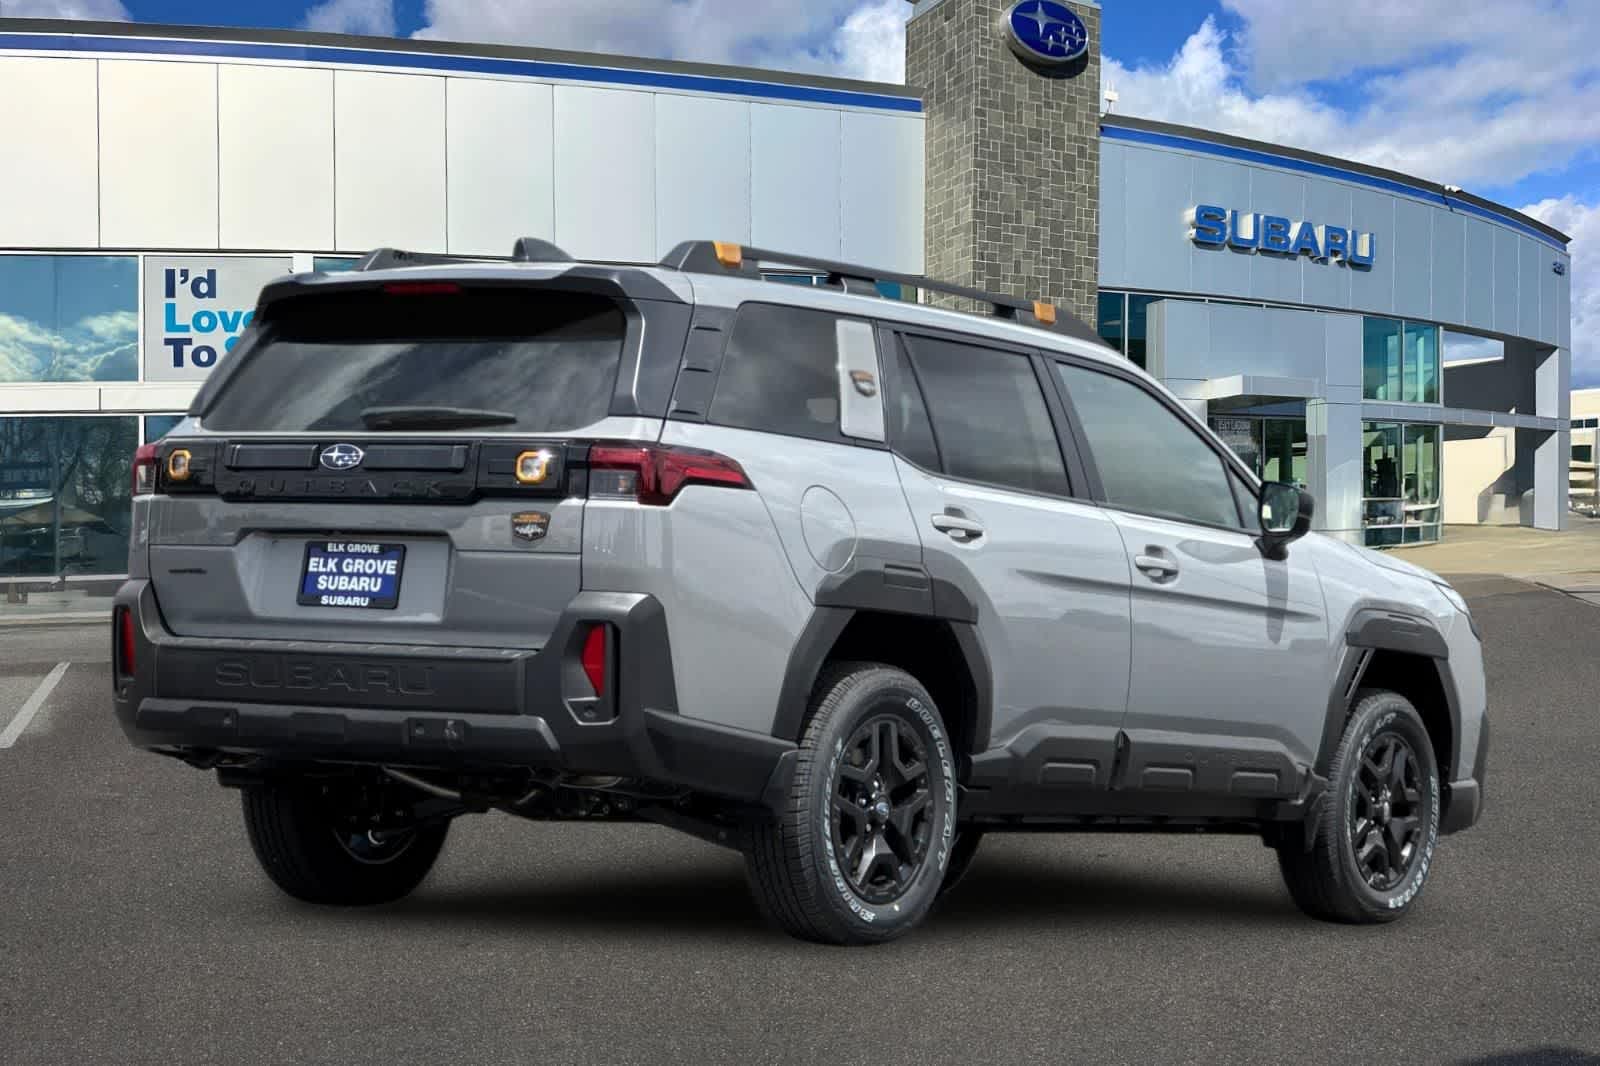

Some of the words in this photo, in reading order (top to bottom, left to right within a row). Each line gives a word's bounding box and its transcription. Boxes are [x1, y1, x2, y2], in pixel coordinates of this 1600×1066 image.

[1191, 203, 1376, 271] SUBARU
[165, 269, 217, 299] I'd
[164, 338, 217, 368] To
[327, 543, 345, 553] ELK
[347, 544, 380, 554] GROVE
[308, 557, 339, 573] ELK
[342, 558, 398, 575] GROVE
[317, 575, 382, 592] SUBARU
[321, 595, 369, 607] SUBARU
[215, 658, 437, 695] SUBARU
